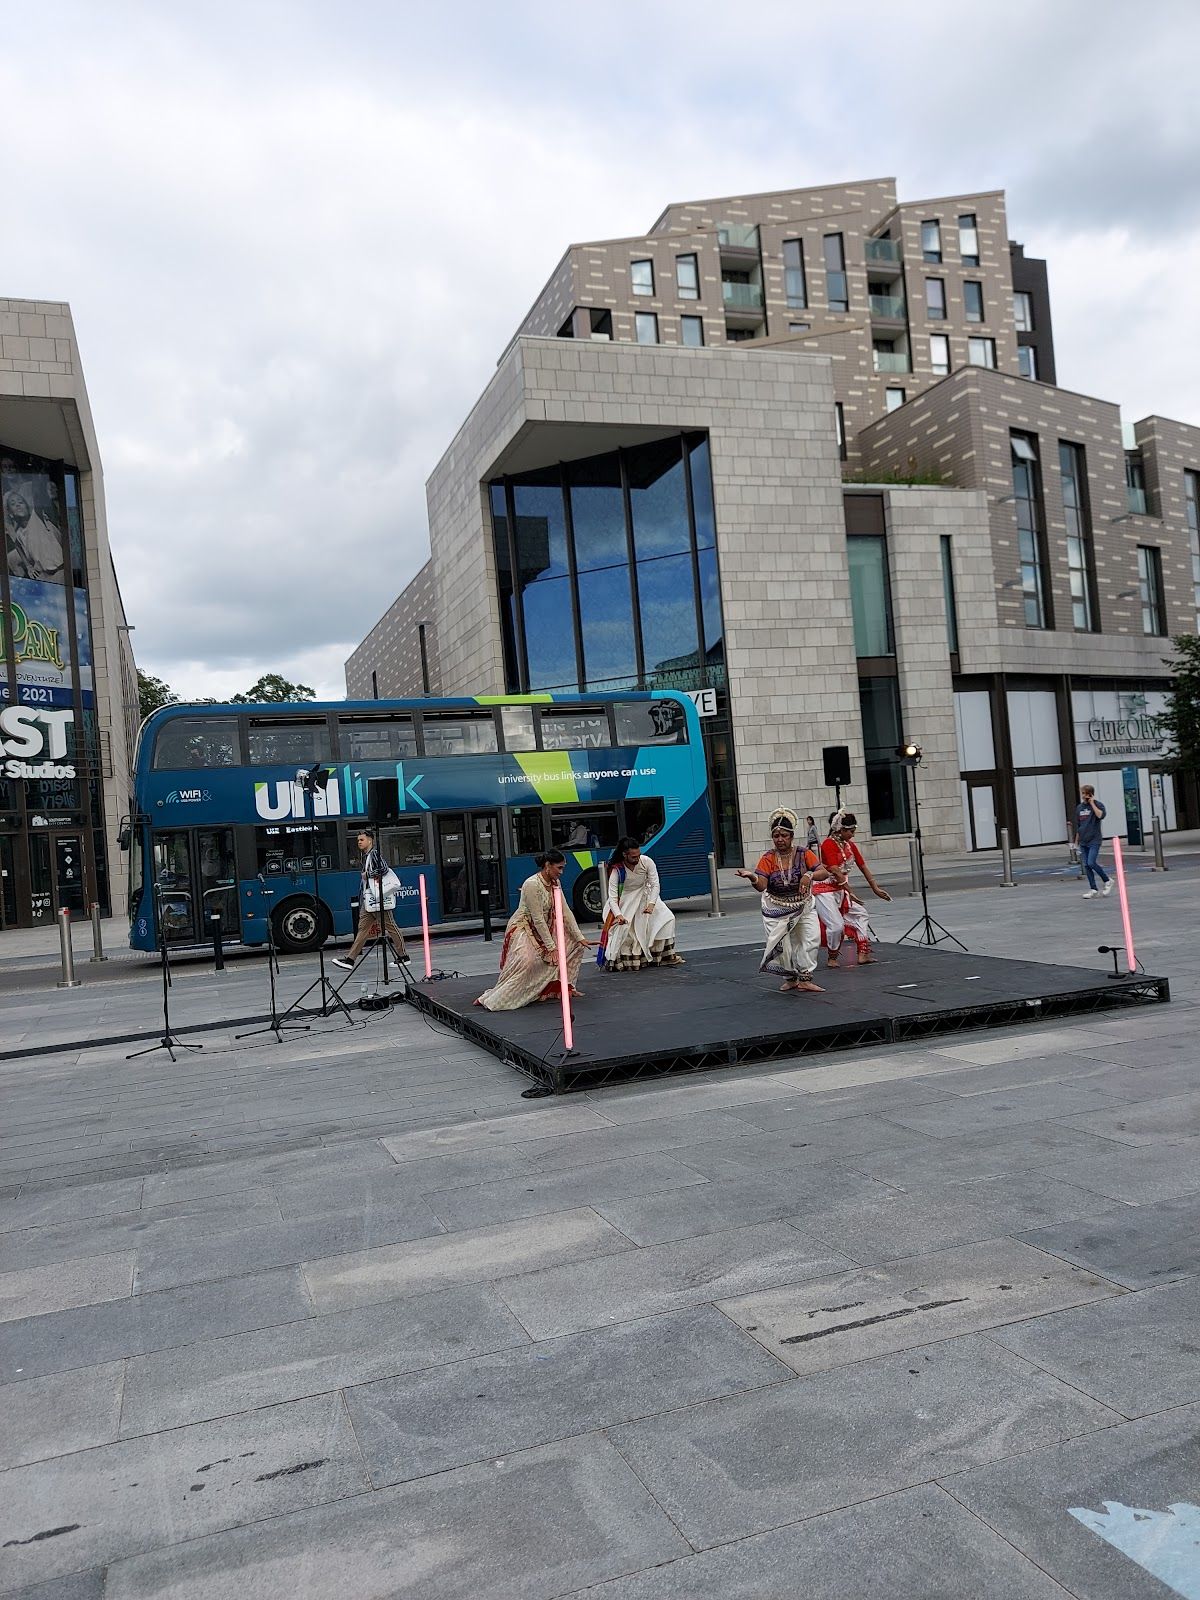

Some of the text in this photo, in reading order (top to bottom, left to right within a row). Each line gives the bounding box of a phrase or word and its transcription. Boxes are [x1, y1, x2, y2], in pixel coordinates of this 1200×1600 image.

[0, 602, 63, 669] PAN
[22, 687, 53, 702] 2021
[0, 706, 75, 760] ST
[5, 760, 76, 779] Studios
[498, 767, 657, 785] university bus links anyone can use
[179, 789, 202, 799] WIFI
